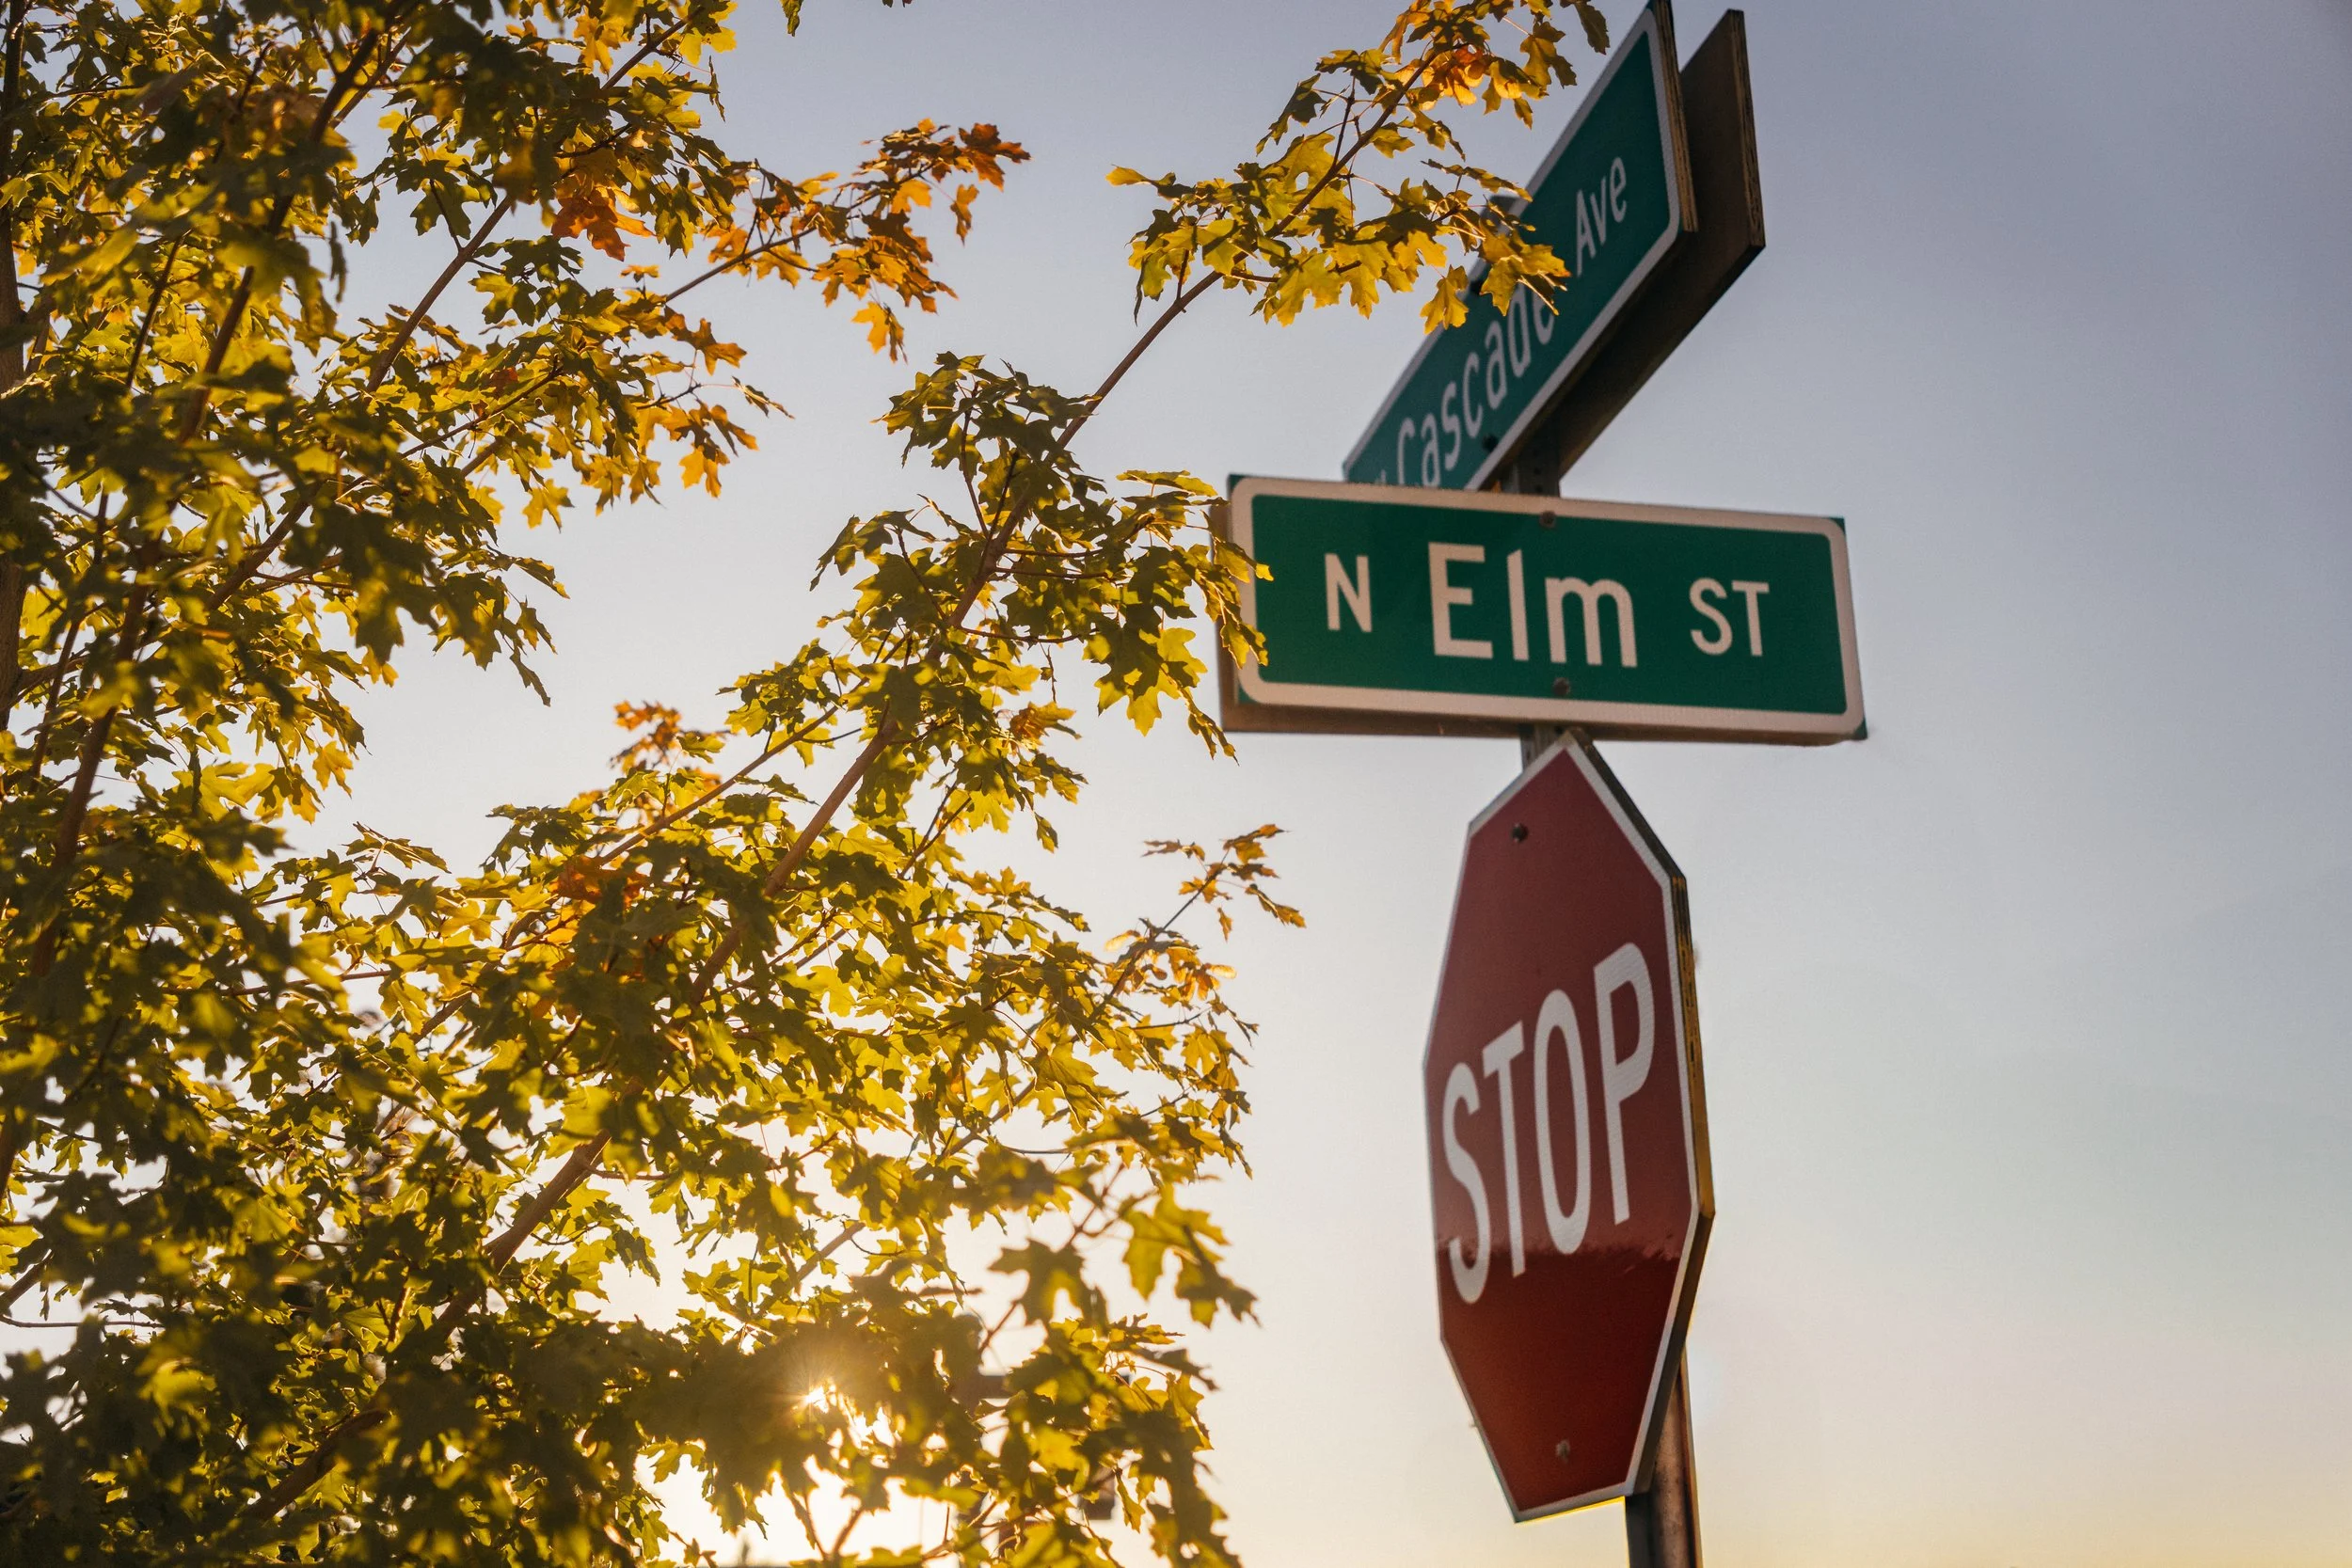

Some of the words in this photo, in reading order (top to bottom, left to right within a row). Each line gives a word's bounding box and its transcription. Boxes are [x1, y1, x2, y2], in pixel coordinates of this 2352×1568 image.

[1575, 156, 1628, 276] Ave
[1324, 552, 1373, 633] N
[1428, 541, 1638, 668] Elm
[1689, 578, 1771, 657] ST
[1442, 942, 1655, 1304] STOP
